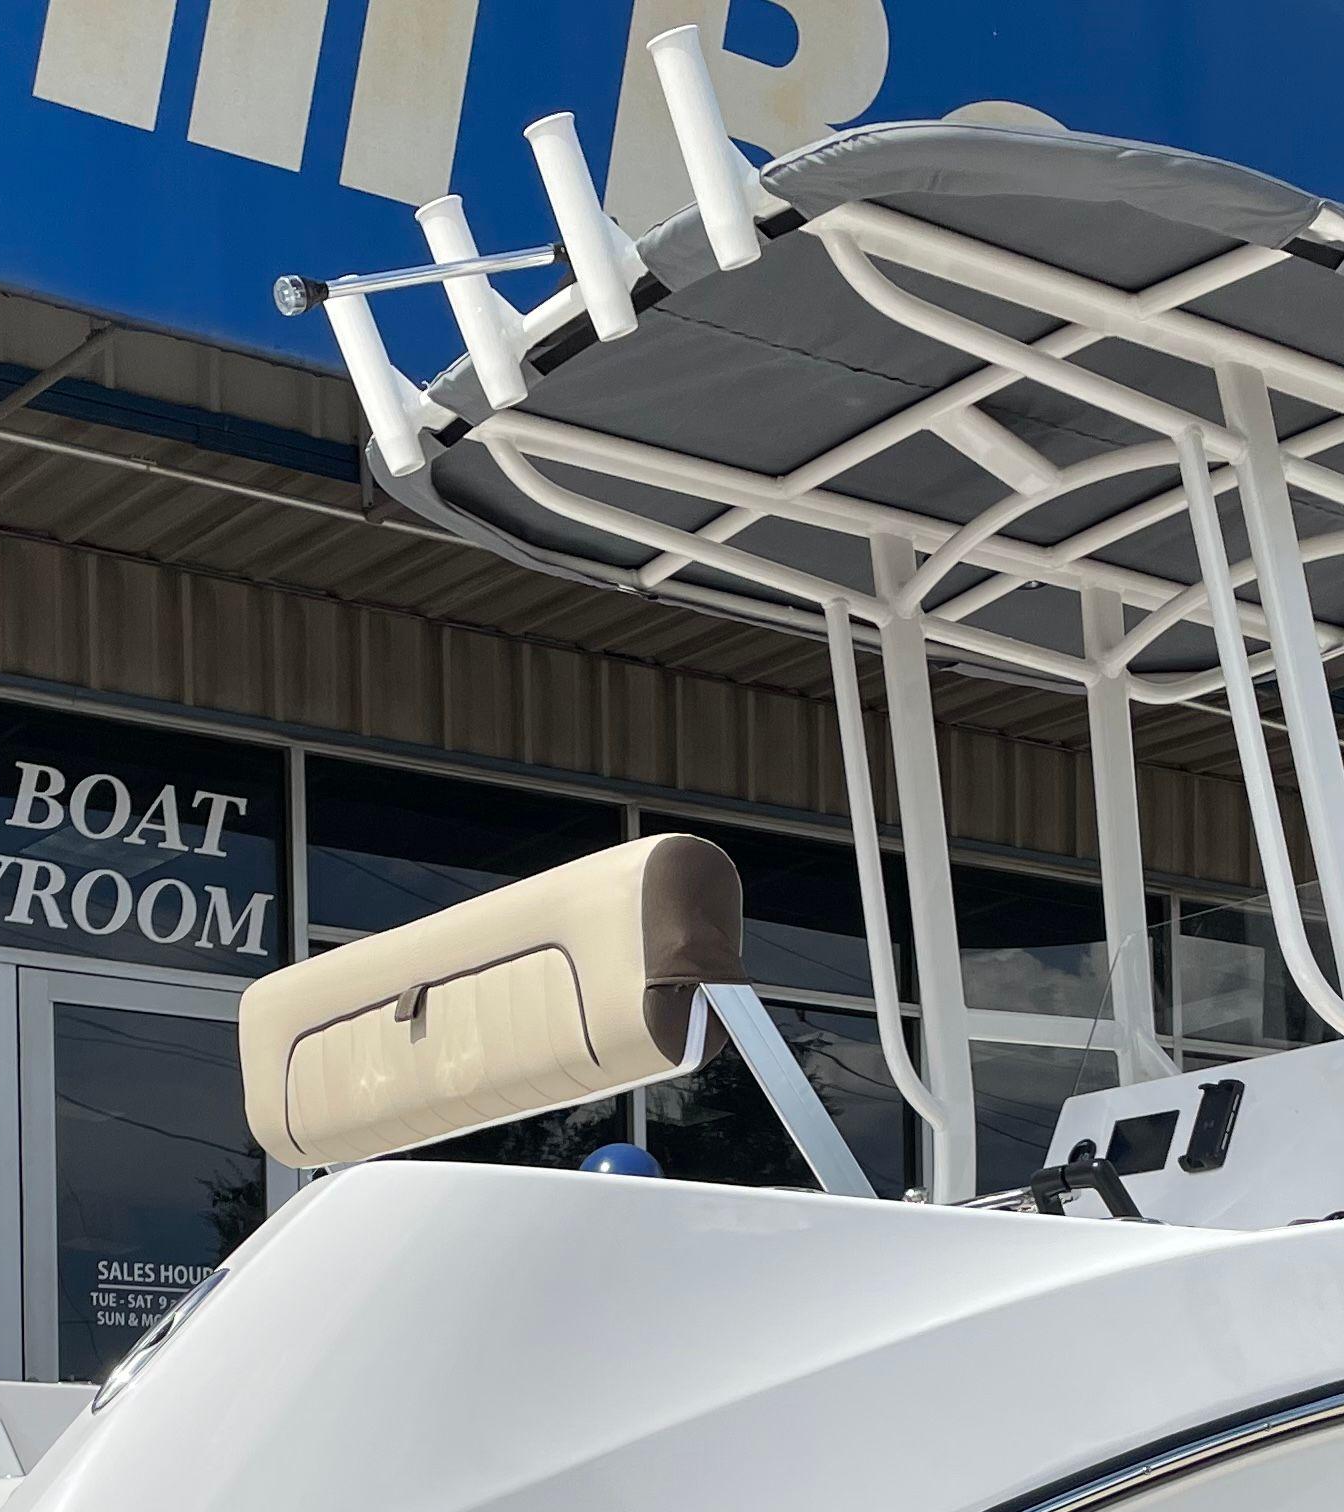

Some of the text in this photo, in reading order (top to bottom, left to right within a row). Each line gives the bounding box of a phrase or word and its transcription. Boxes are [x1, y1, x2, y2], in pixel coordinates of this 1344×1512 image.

[4, 760, 248, 858] BOAT
[97, 1260, 156, 1283] SALES
[89, 1291, 118, 1307] TUE
[127, 1294, 154, 1309] SAT
[158, 1295, 168, 1310] 9
[96, 1310, 126, 1327] SUN
[127, 1312, 139, 1327] &
